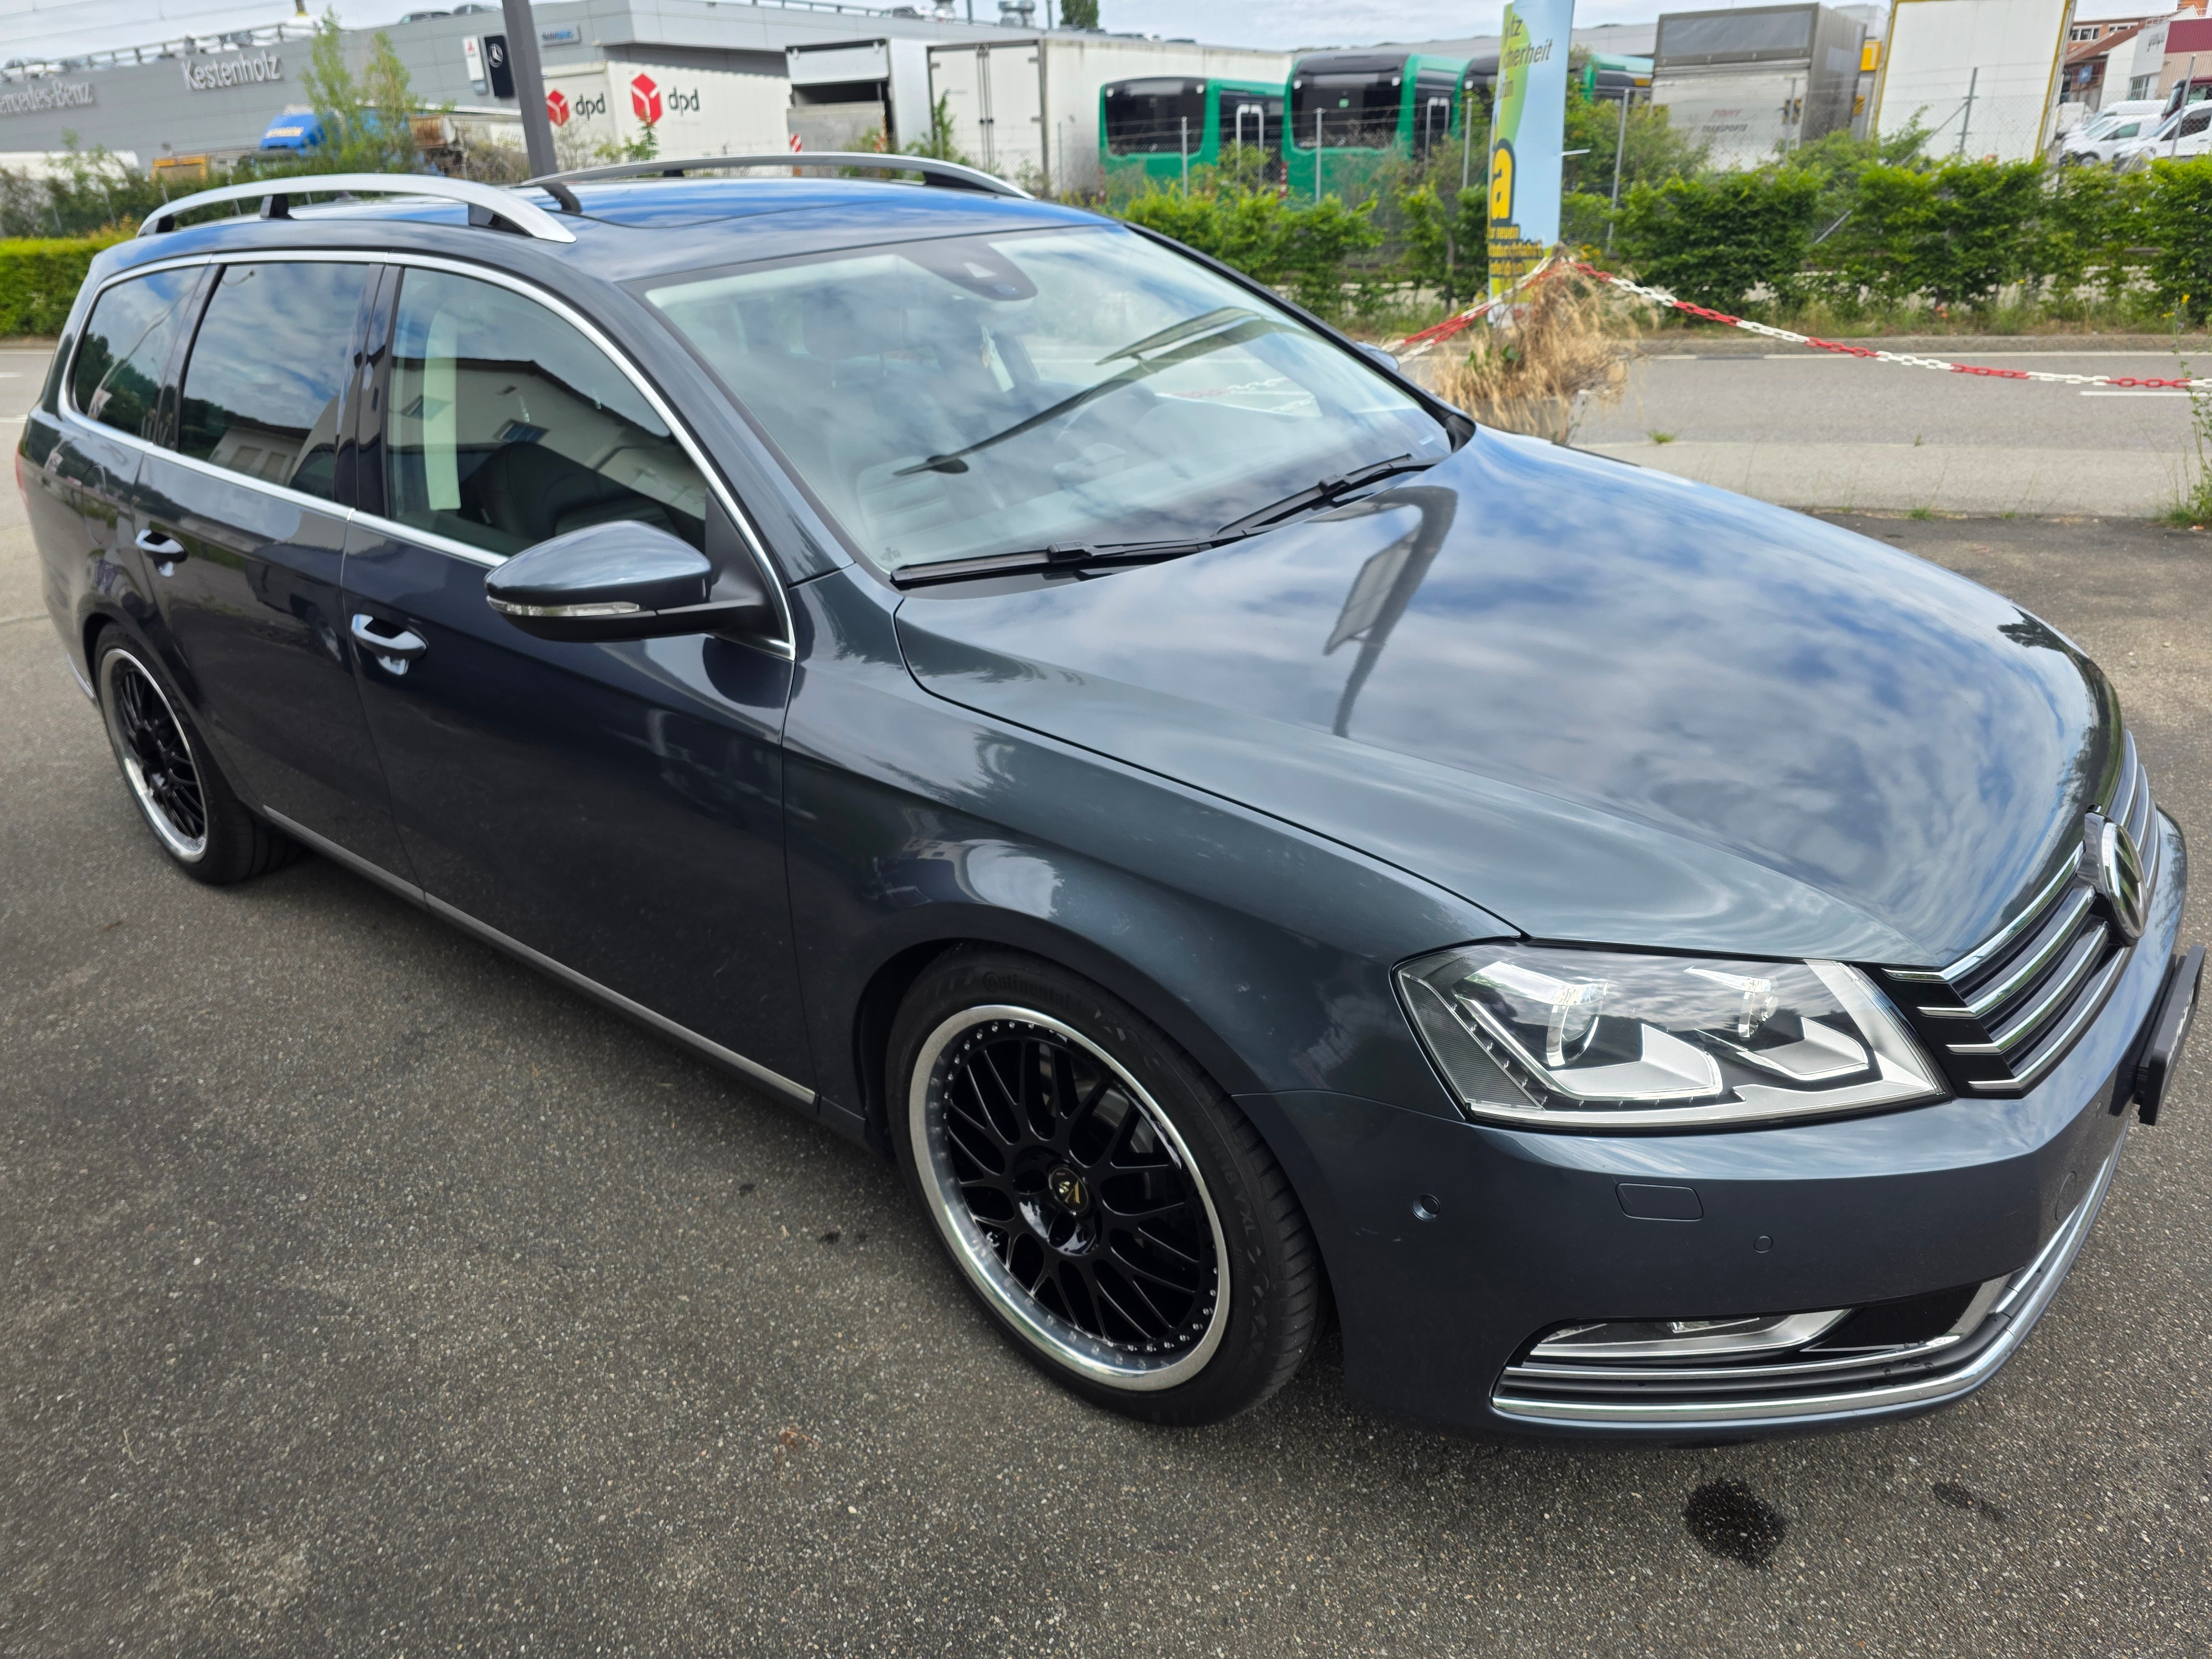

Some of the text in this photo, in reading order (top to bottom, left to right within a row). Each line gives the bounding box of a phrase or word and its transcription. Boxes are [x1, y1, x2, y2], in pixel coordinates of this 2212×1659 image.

[181, 49, 281, 91] Kestenholz
[0, 80, 93, 116] ercedes-Benz
[575, 92, 606, 120] dpd
[668, 86, 700, 116] dpd
[1489, 138, 1514, 220] a
[982, 971, 1072, 1009] Continental
